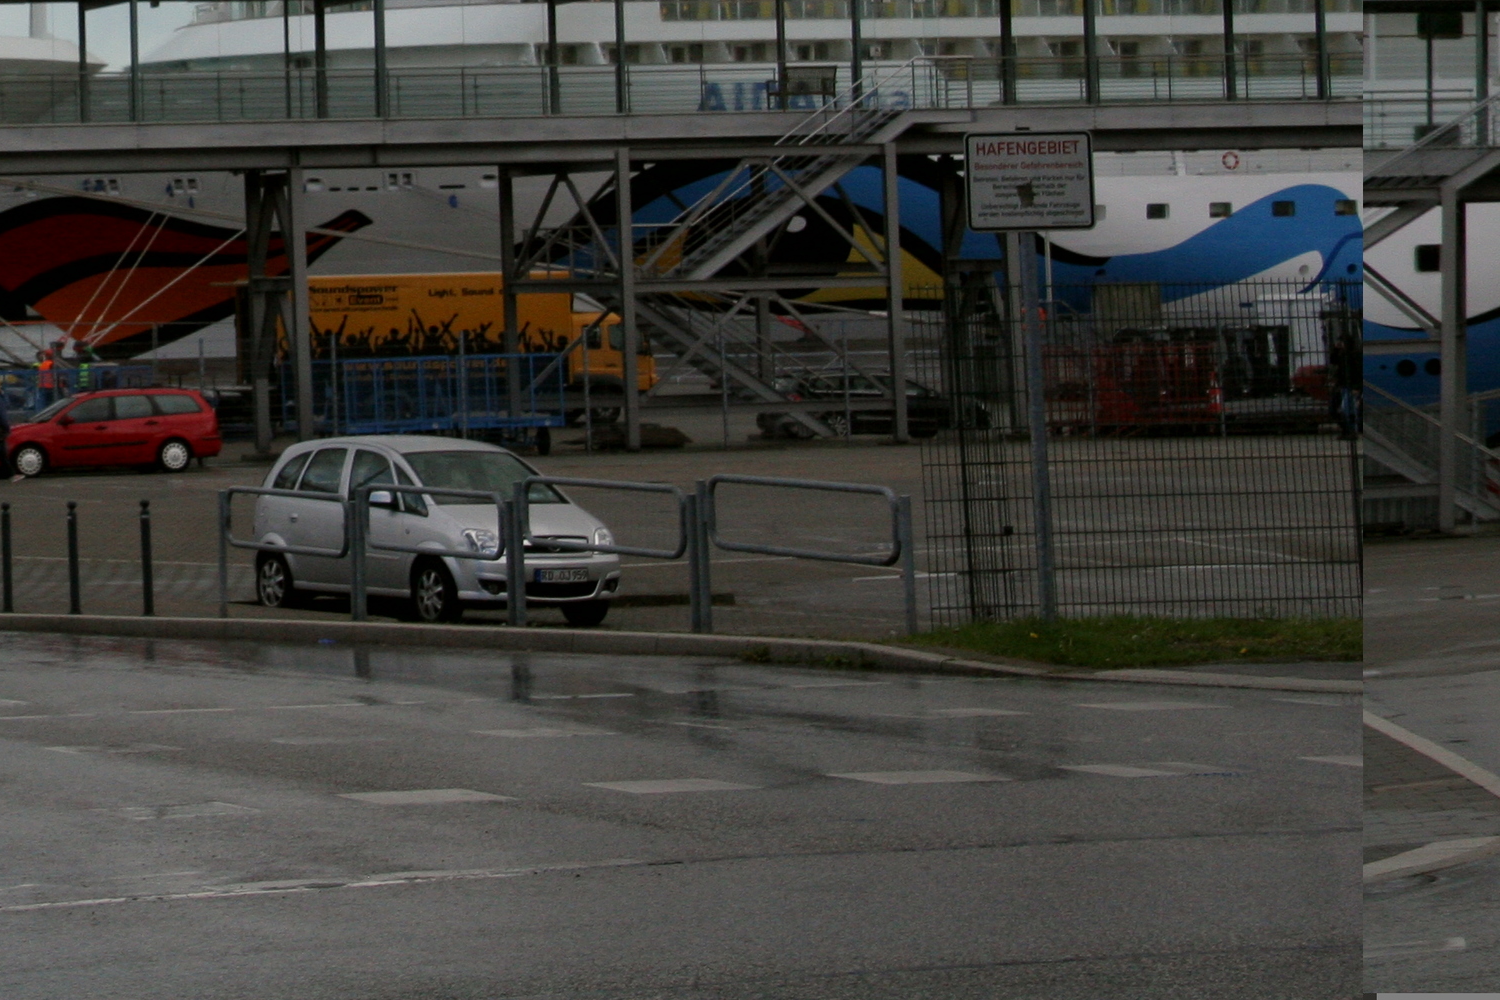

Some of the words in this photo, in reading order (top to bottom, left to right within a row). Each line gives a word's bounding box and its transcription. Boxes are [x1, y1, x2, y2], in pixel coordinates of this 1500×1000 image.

[975, 140, 1080, 156] HAFENGEBIET
[973, 162, 1018, 171] Besonderer
[1020, 160, 1084, 170] Gefahrenbereich
